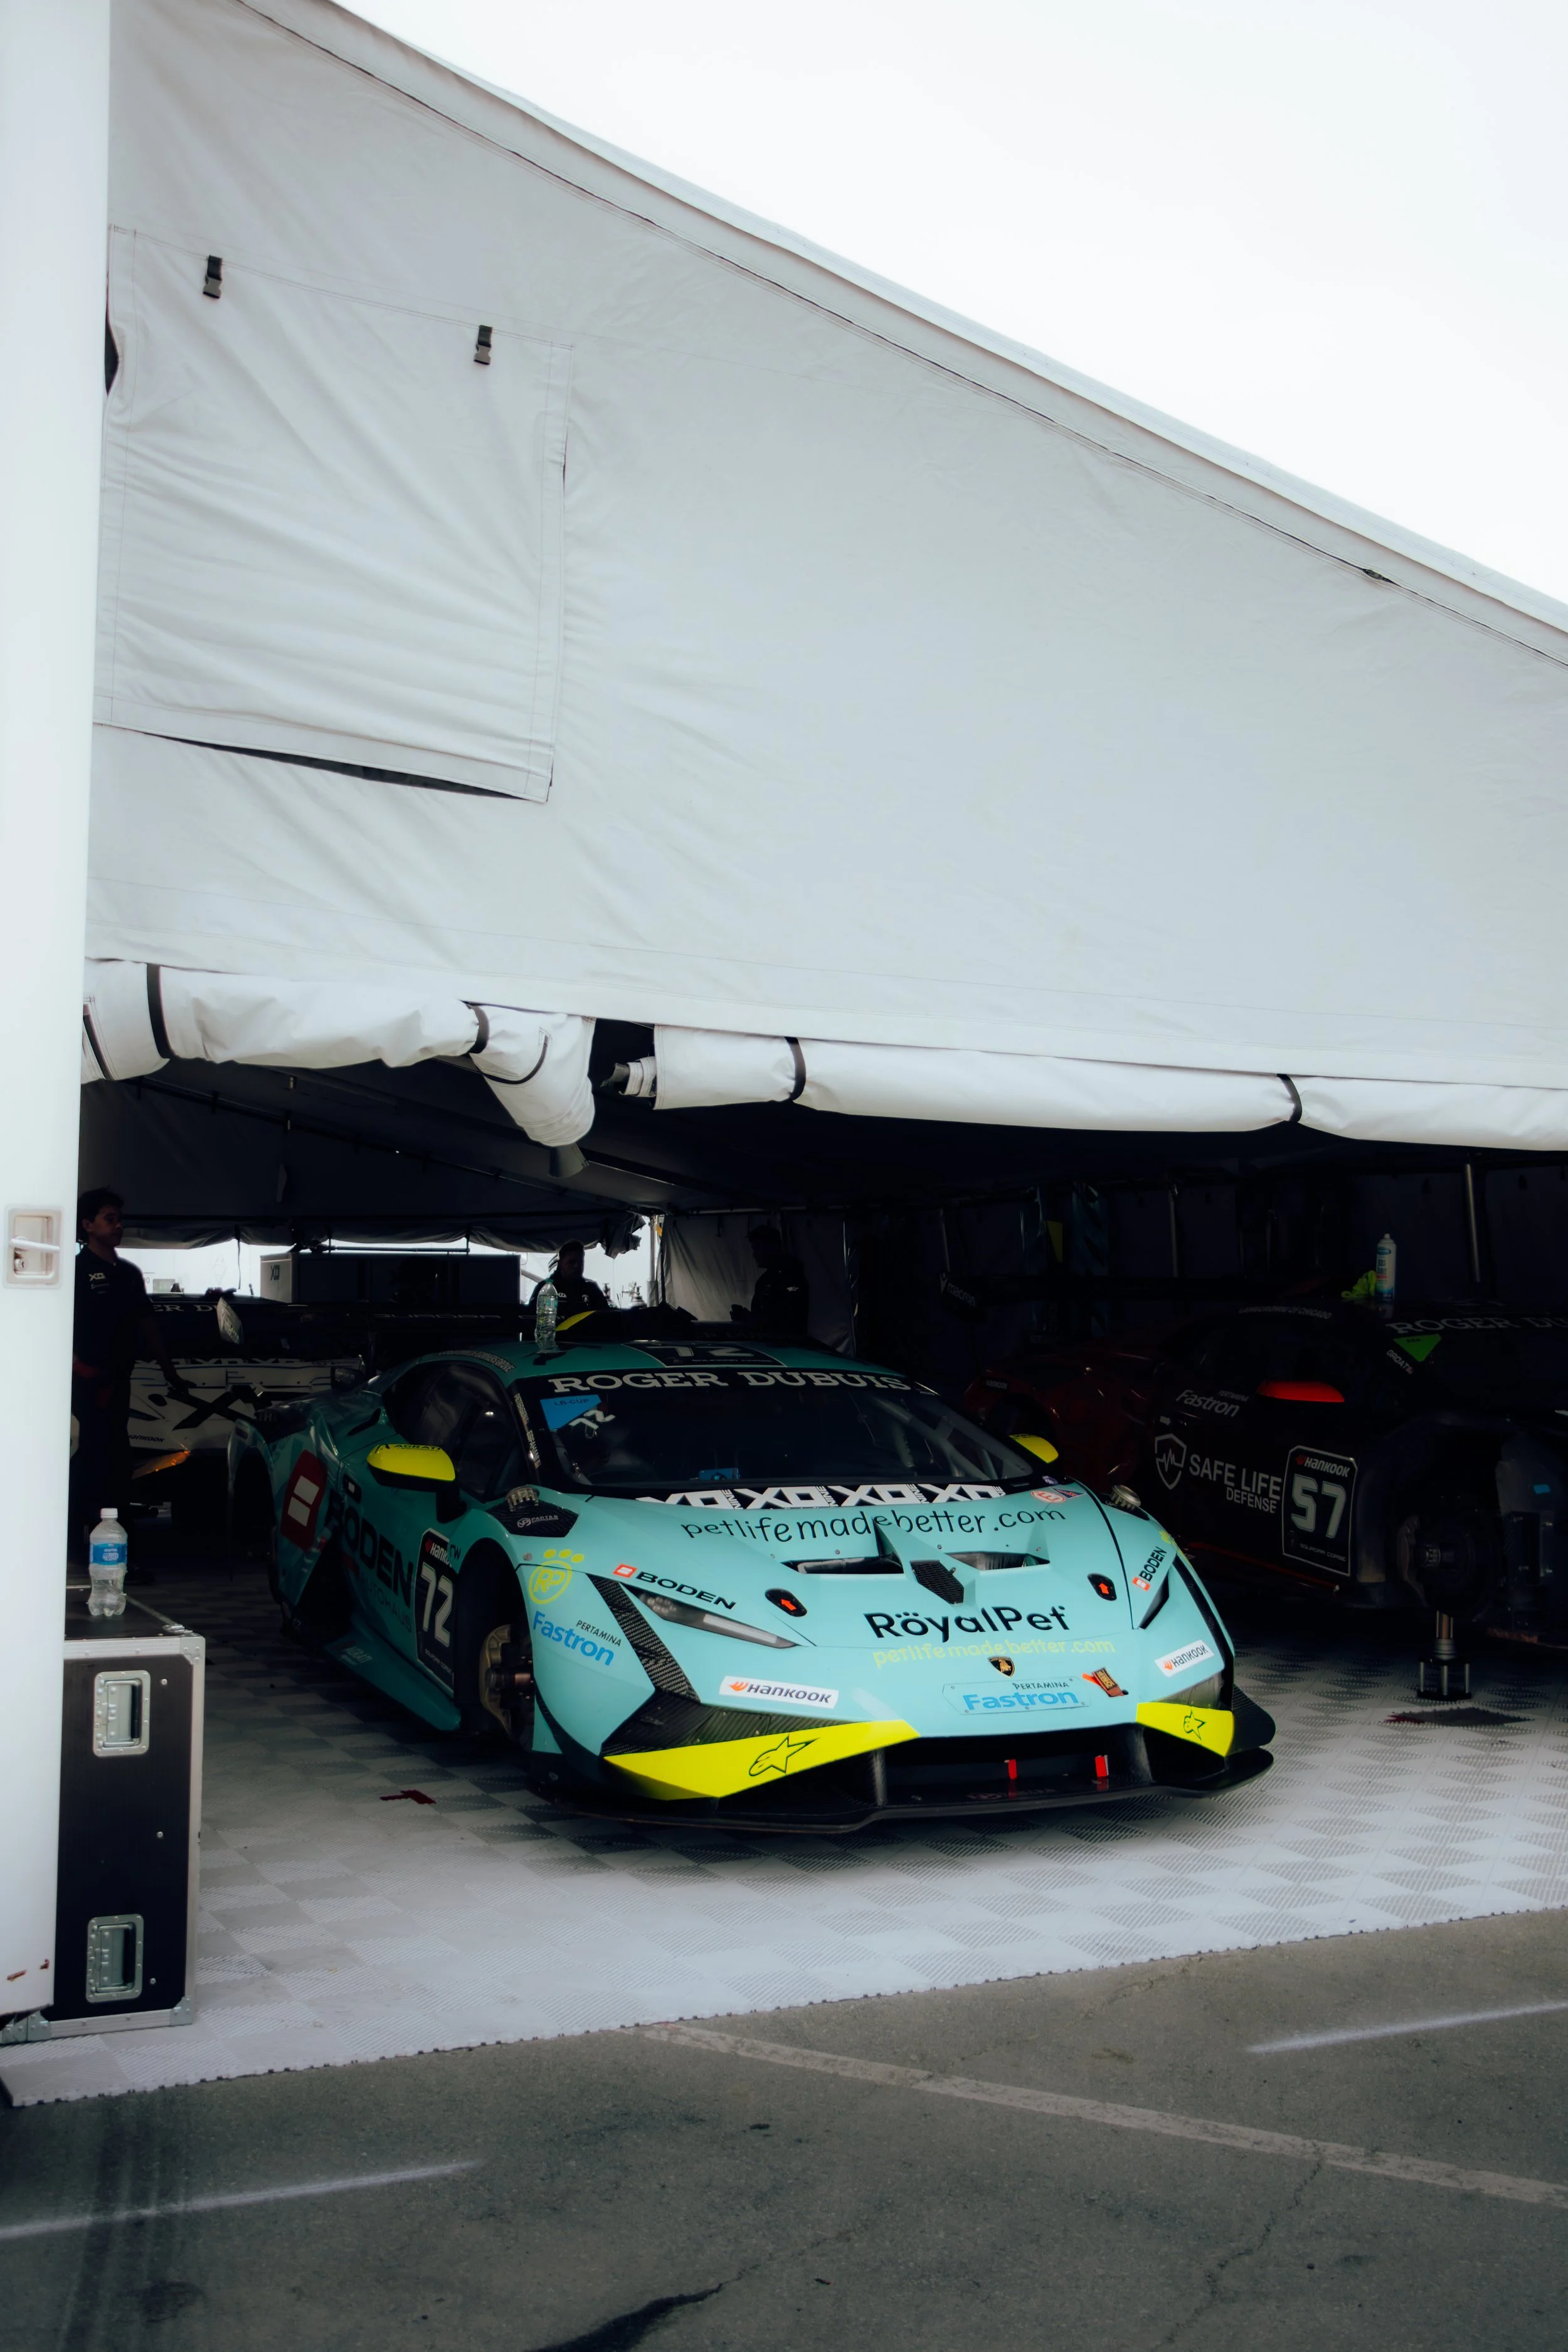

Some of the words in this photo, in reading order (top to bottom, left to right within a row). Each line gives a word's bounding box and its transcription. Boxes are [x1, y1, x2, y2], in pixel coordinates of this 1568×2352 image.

[947, 1282, 977, 1308] macron
[1385, 1316, 1522, 1334] ROGER
[548, 1372, 729, 1393] ROGER
[737, 1372, 912, 1391] DUBUIS
[1175, 1389, 1240, 1417] Fastron
[1189, 1454, 1236, 1488] SAFE
[1241, 1468, 1282, 1502] LIFE
[733, 1486, 831, 1510] XO
[827, 1484, 923, 1507] XO
[1226, 1486, 1277, 1514] DEFENSE
[1290, 1473, 1347, 1539] 57
[1138, 1545, 1167, 1582] BODEN
[636, 1571, 737, 1610] BODEN
[420, 1561, 454, 1648] 72
[532, 1611, 615, 1666] Fastron
[576, 1620, 622, 1647] PERTAMINA
[1014, 1682, 1069, 1690] PERTAMINA
[963, 1691, 1079, 1711] Fastron
